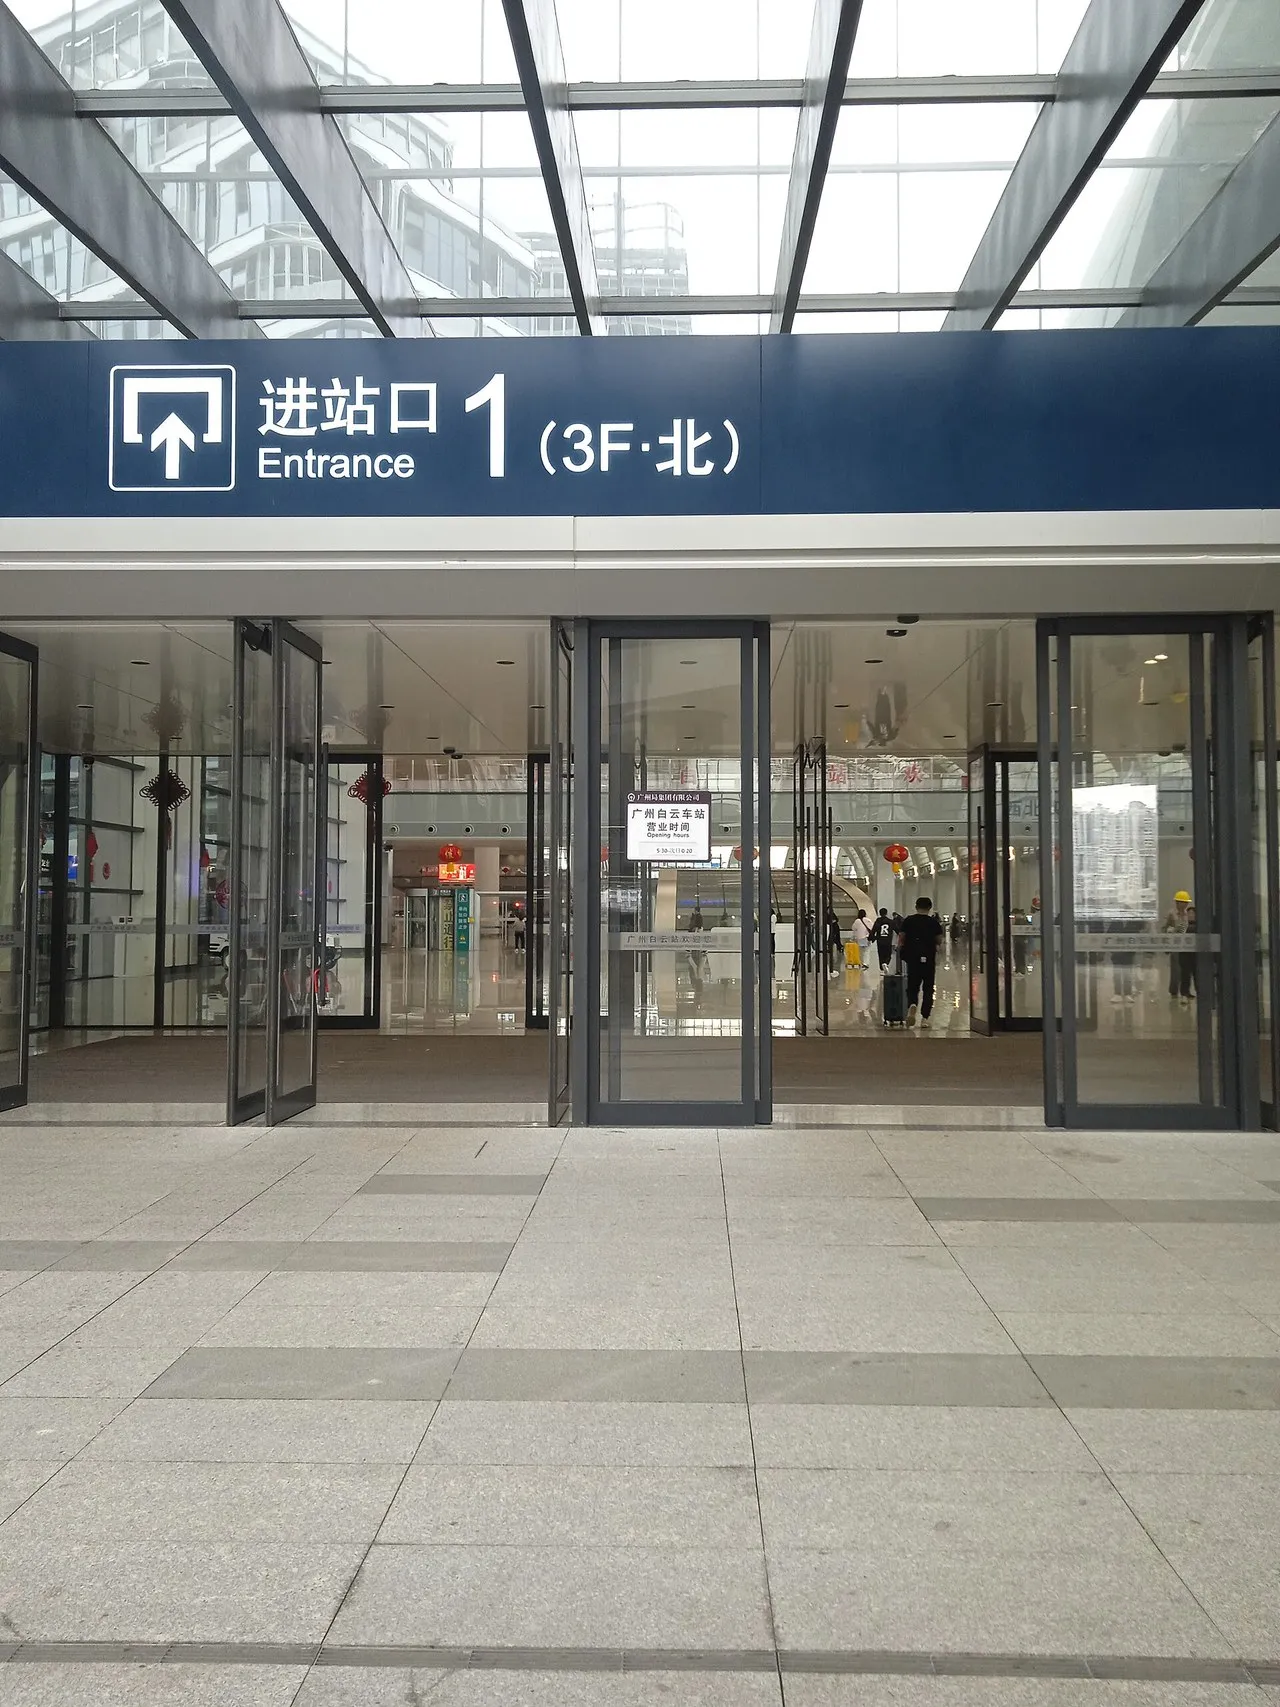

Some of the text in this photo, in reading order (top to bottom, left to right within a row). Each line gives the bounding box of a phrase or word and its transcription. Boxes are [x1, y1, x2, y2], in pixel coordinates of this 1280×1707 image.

[258, 376, 436, 435] 进站口
[465, 374, 504, 477] 1
[259, 448, 414, 478] Entrance
[631, 808, 705, 820] 广州白云车站
[646, 821, 690, 832] 营业时间
